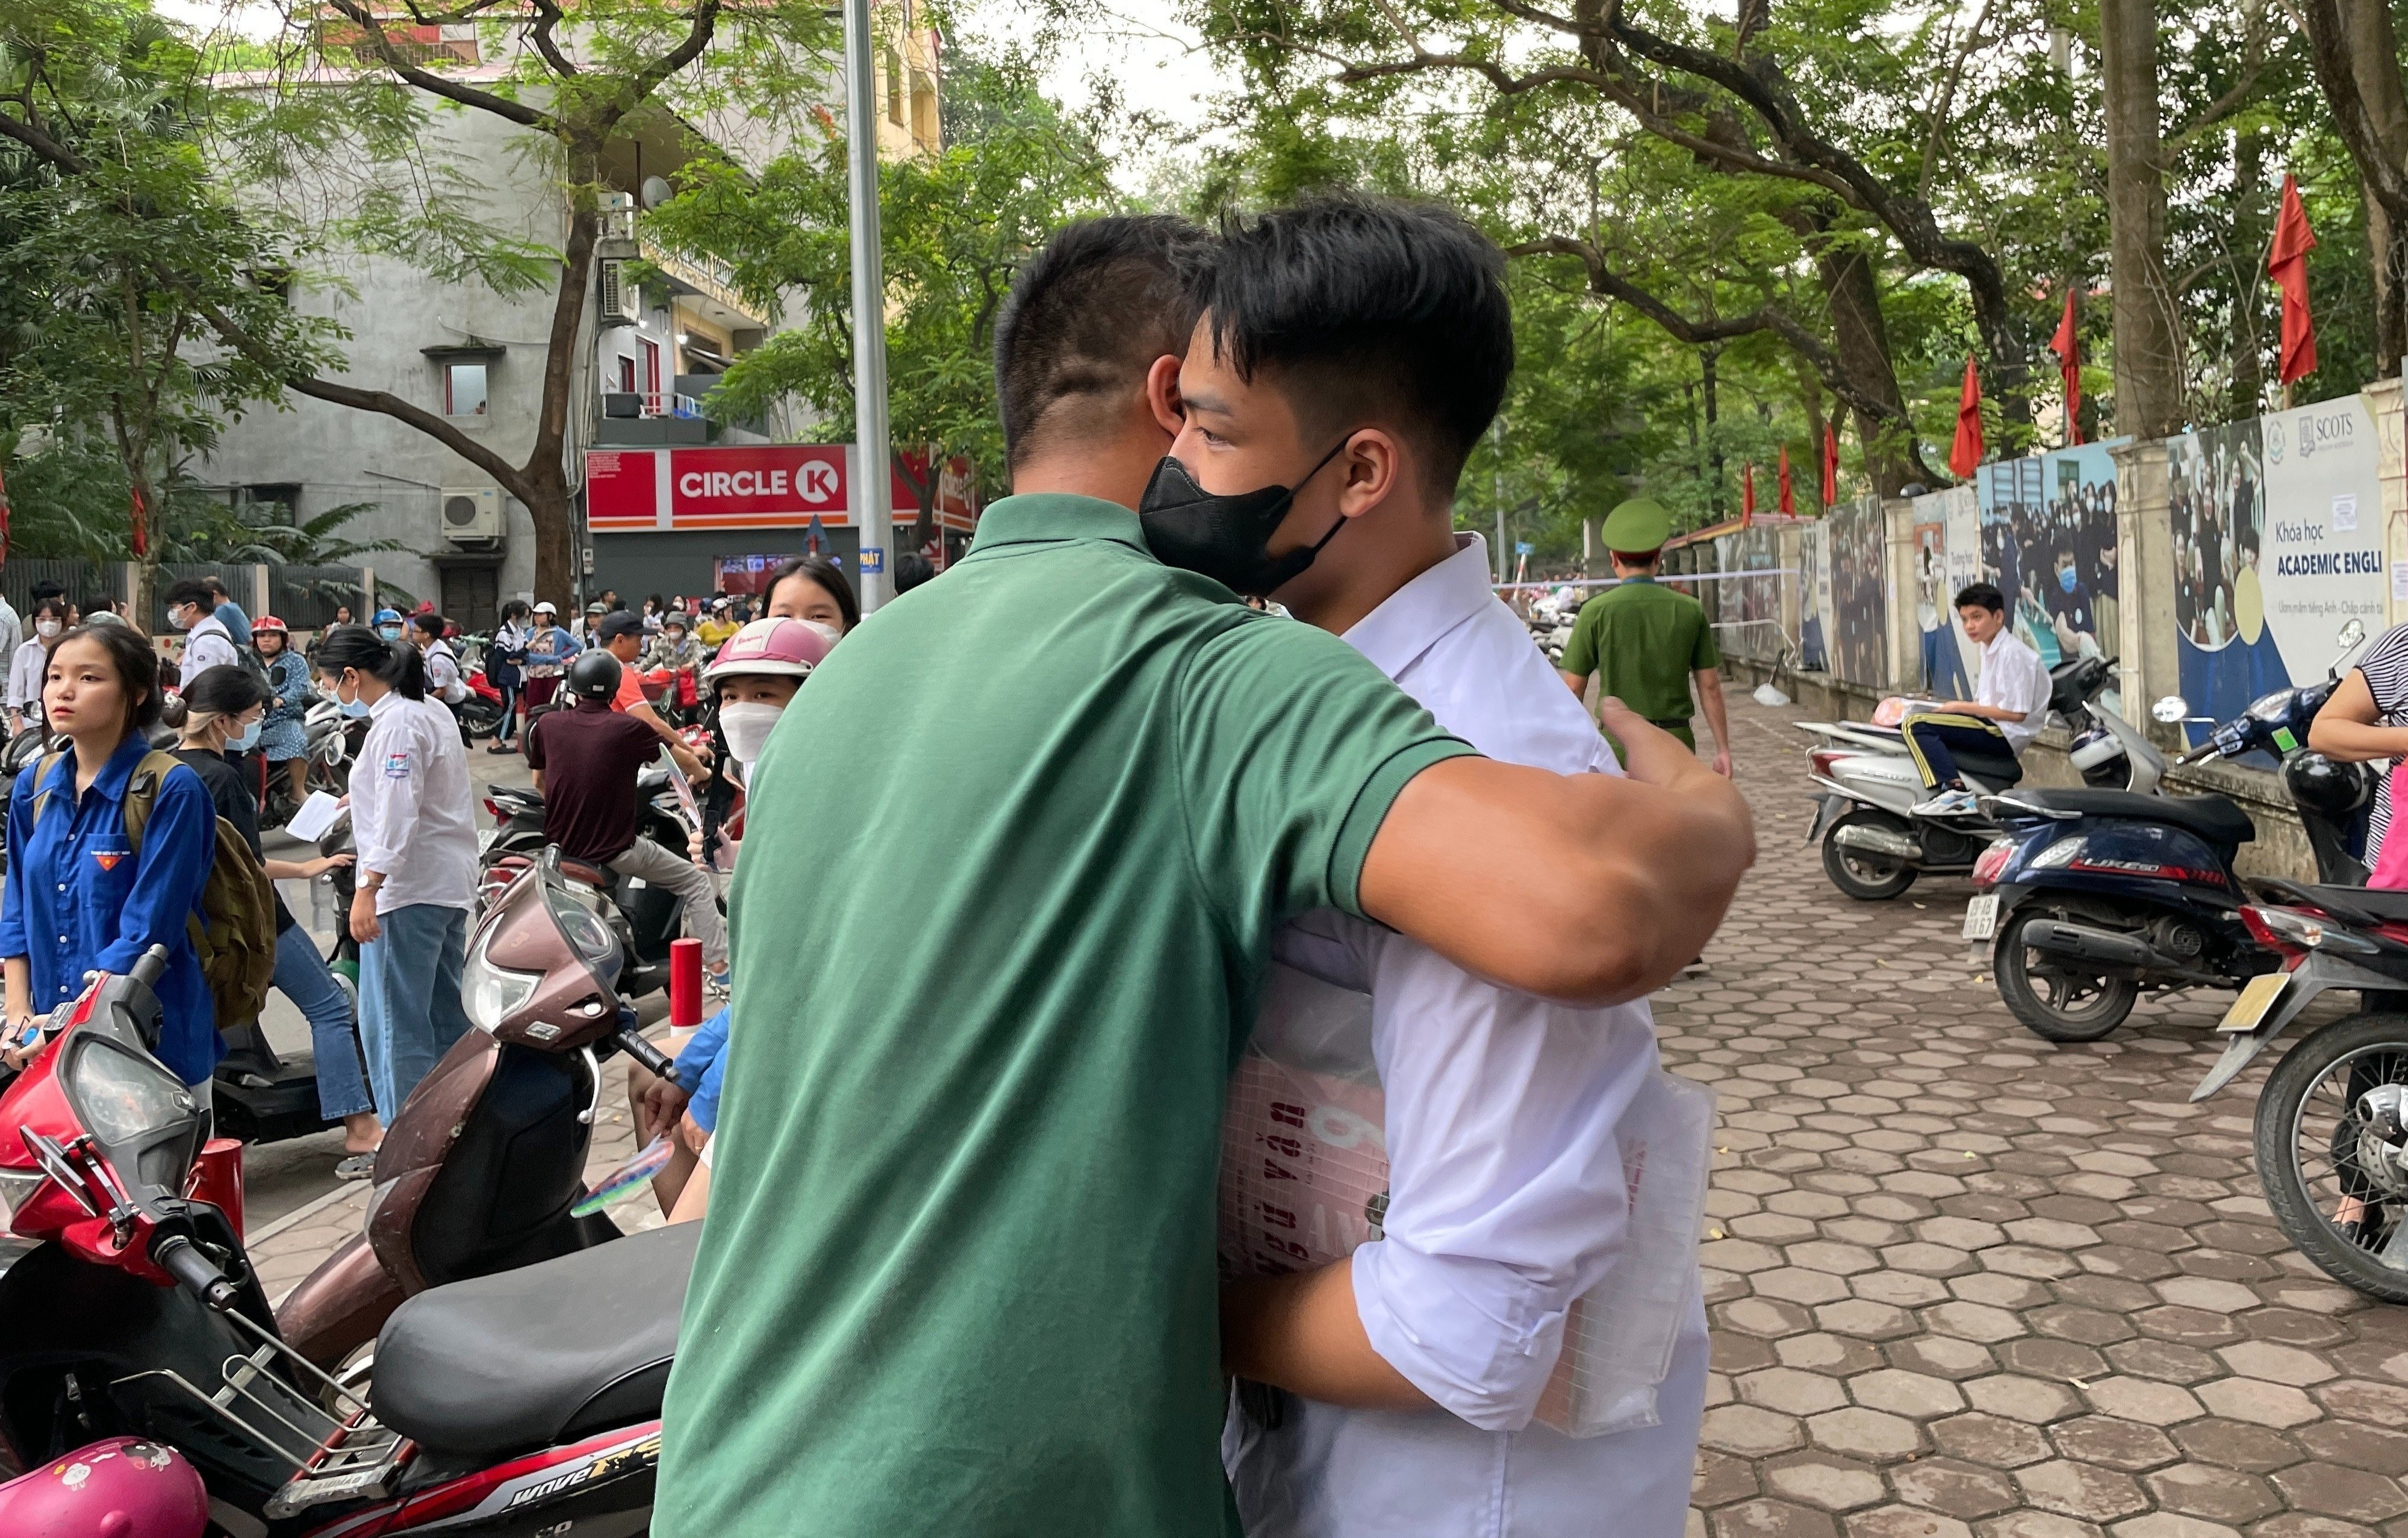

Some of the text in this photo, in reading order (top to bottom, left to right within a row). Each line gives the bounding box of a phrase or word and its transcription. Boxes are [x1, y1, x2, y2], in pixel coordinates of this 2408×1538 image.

[2316, 412, 2353, 441] SCOTS
[680, 465, 838, 503] CIRCLE K
[2276, 518, 2324, 545] Khóa học
[2278, 550, 2382, 576] ACADEMIC ENGLI
[2325, 601, 2337, 614] Anh
[1255, 1102, 1305, 1180] văn
